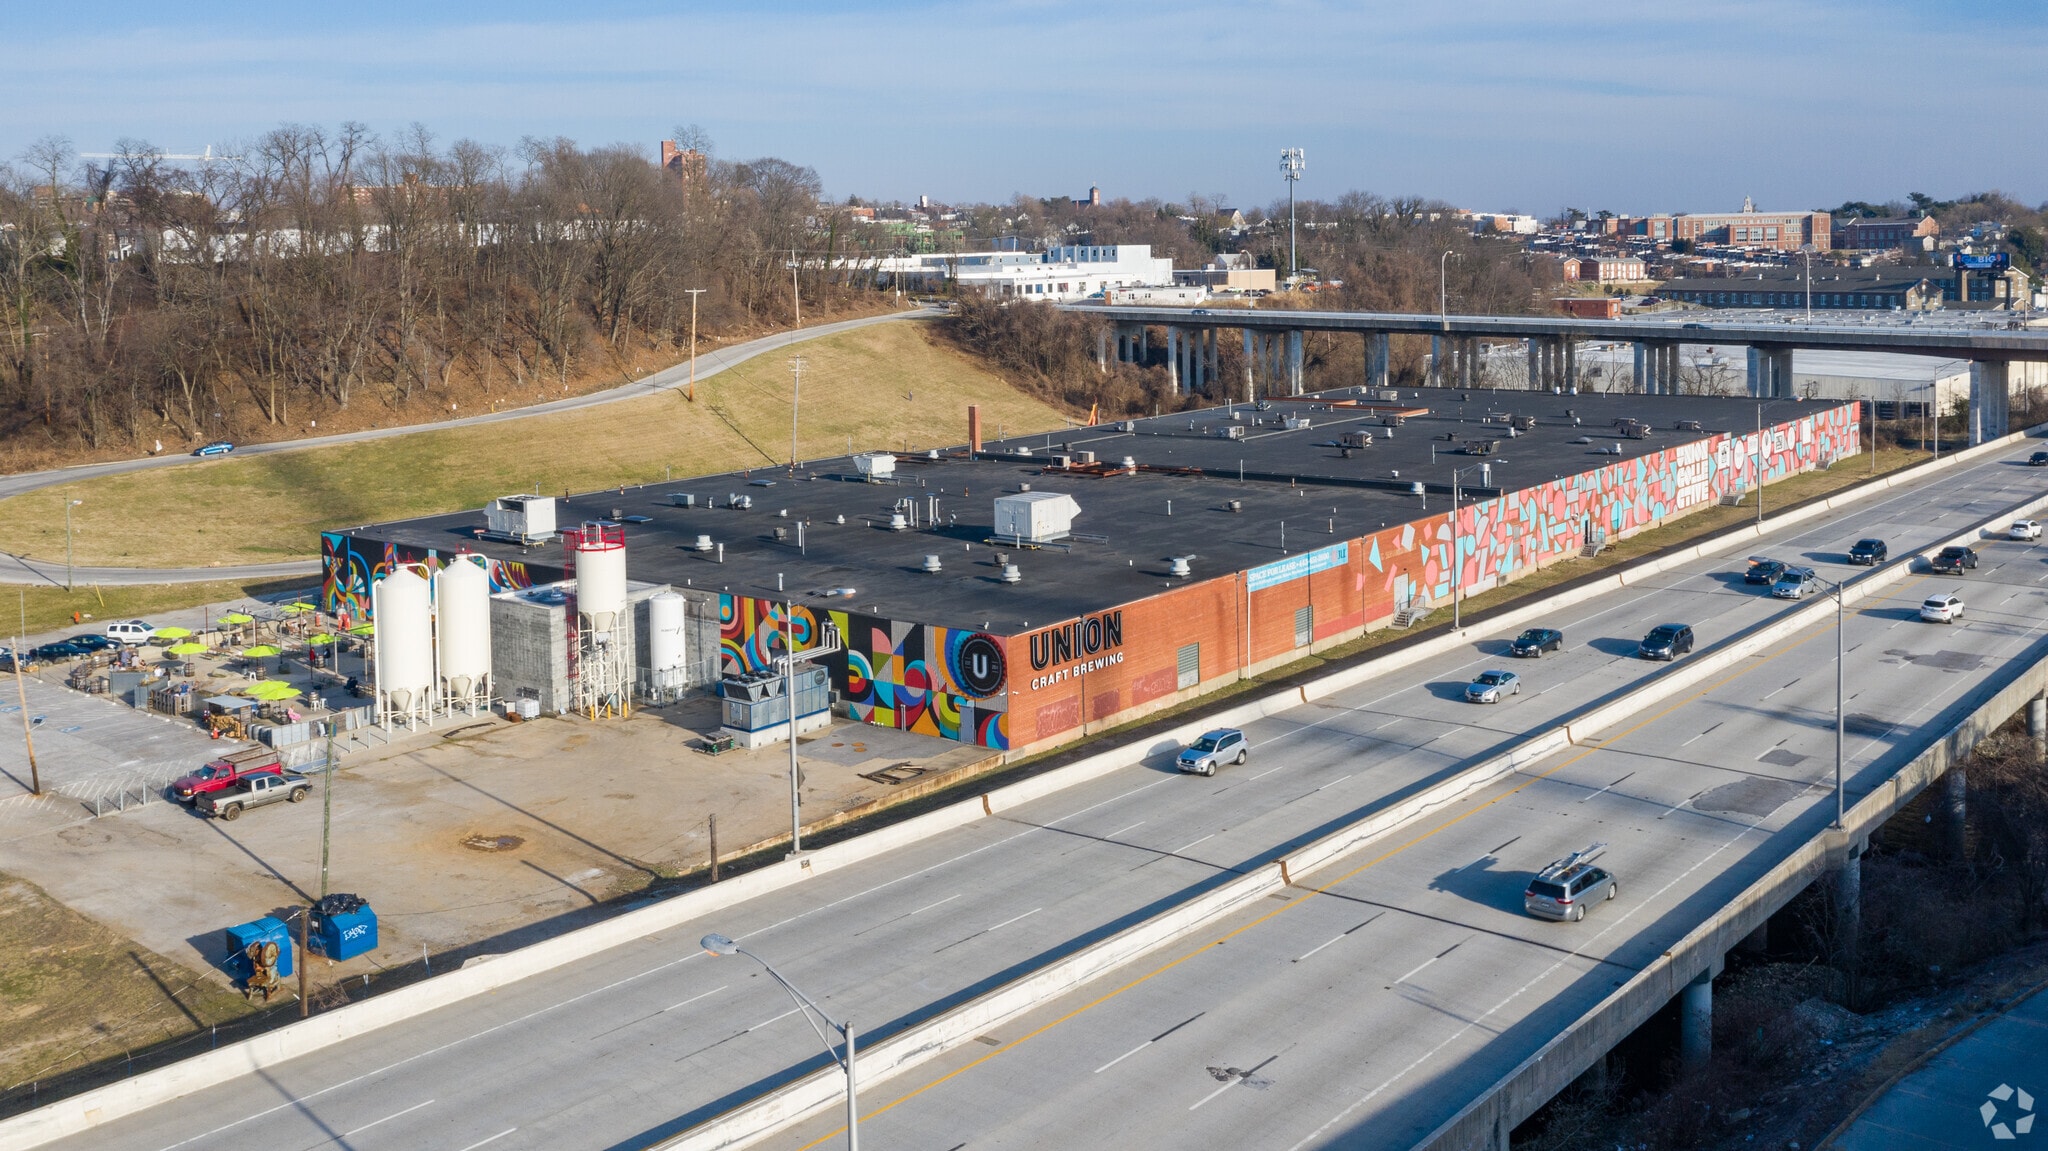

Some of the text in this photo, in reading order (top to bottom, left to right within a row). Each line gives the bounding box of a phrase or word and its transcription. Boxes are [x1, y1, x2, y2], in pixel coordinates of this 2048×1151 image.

[1676, 439, 1709, 467] UNION
[1249, 570, 1268, 582] SPACE
[1267, 566, 1279, 577] FOR
[1279, 561, 1297, 574] LEASE
[1030, 610, 1122, 670] UNION
[972, 653, 987, 679] U
[1031, 651, 1124, 691] CRAFT BREWING
